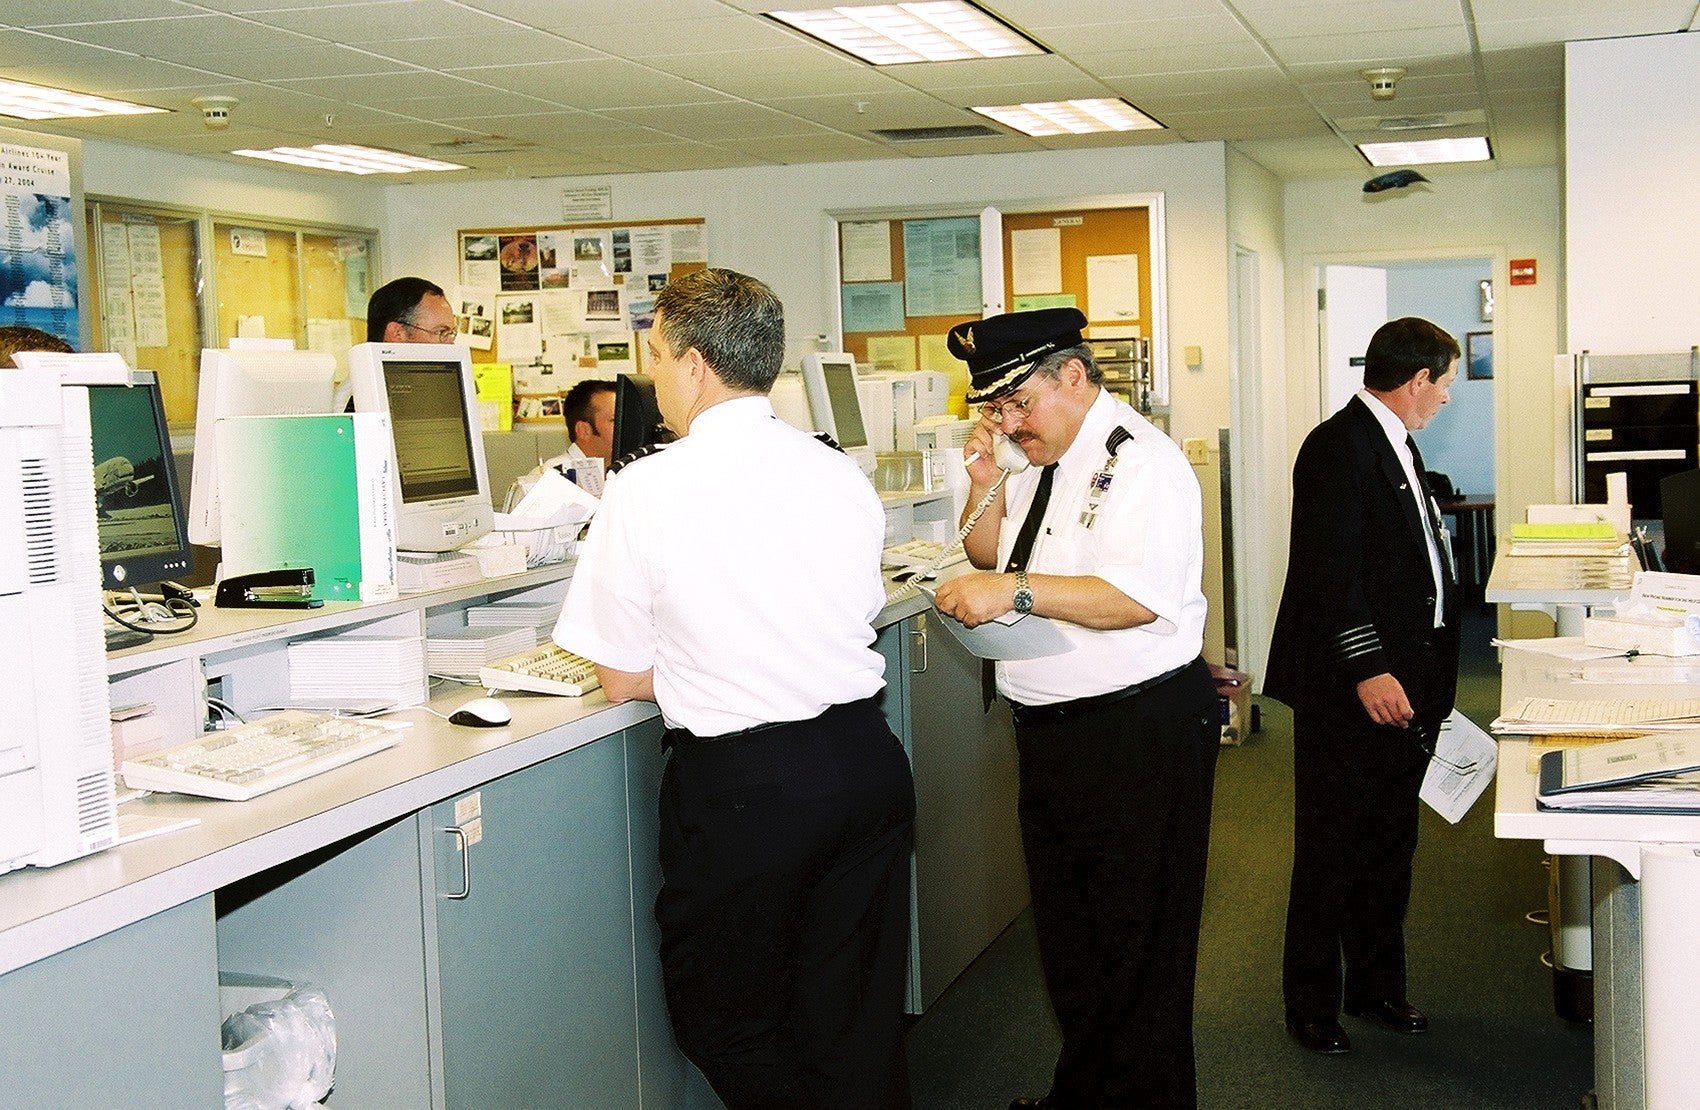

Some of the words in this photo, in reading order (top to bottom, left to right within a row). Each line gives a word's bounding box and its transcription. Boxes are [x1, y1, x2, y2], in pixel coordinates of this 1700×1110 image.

[47, 154, 61, 162] Year
[8, 162, 30, 173] Award
[32, 165, 55, 176] Cruise
[18, 178, 35, 187] 2004
